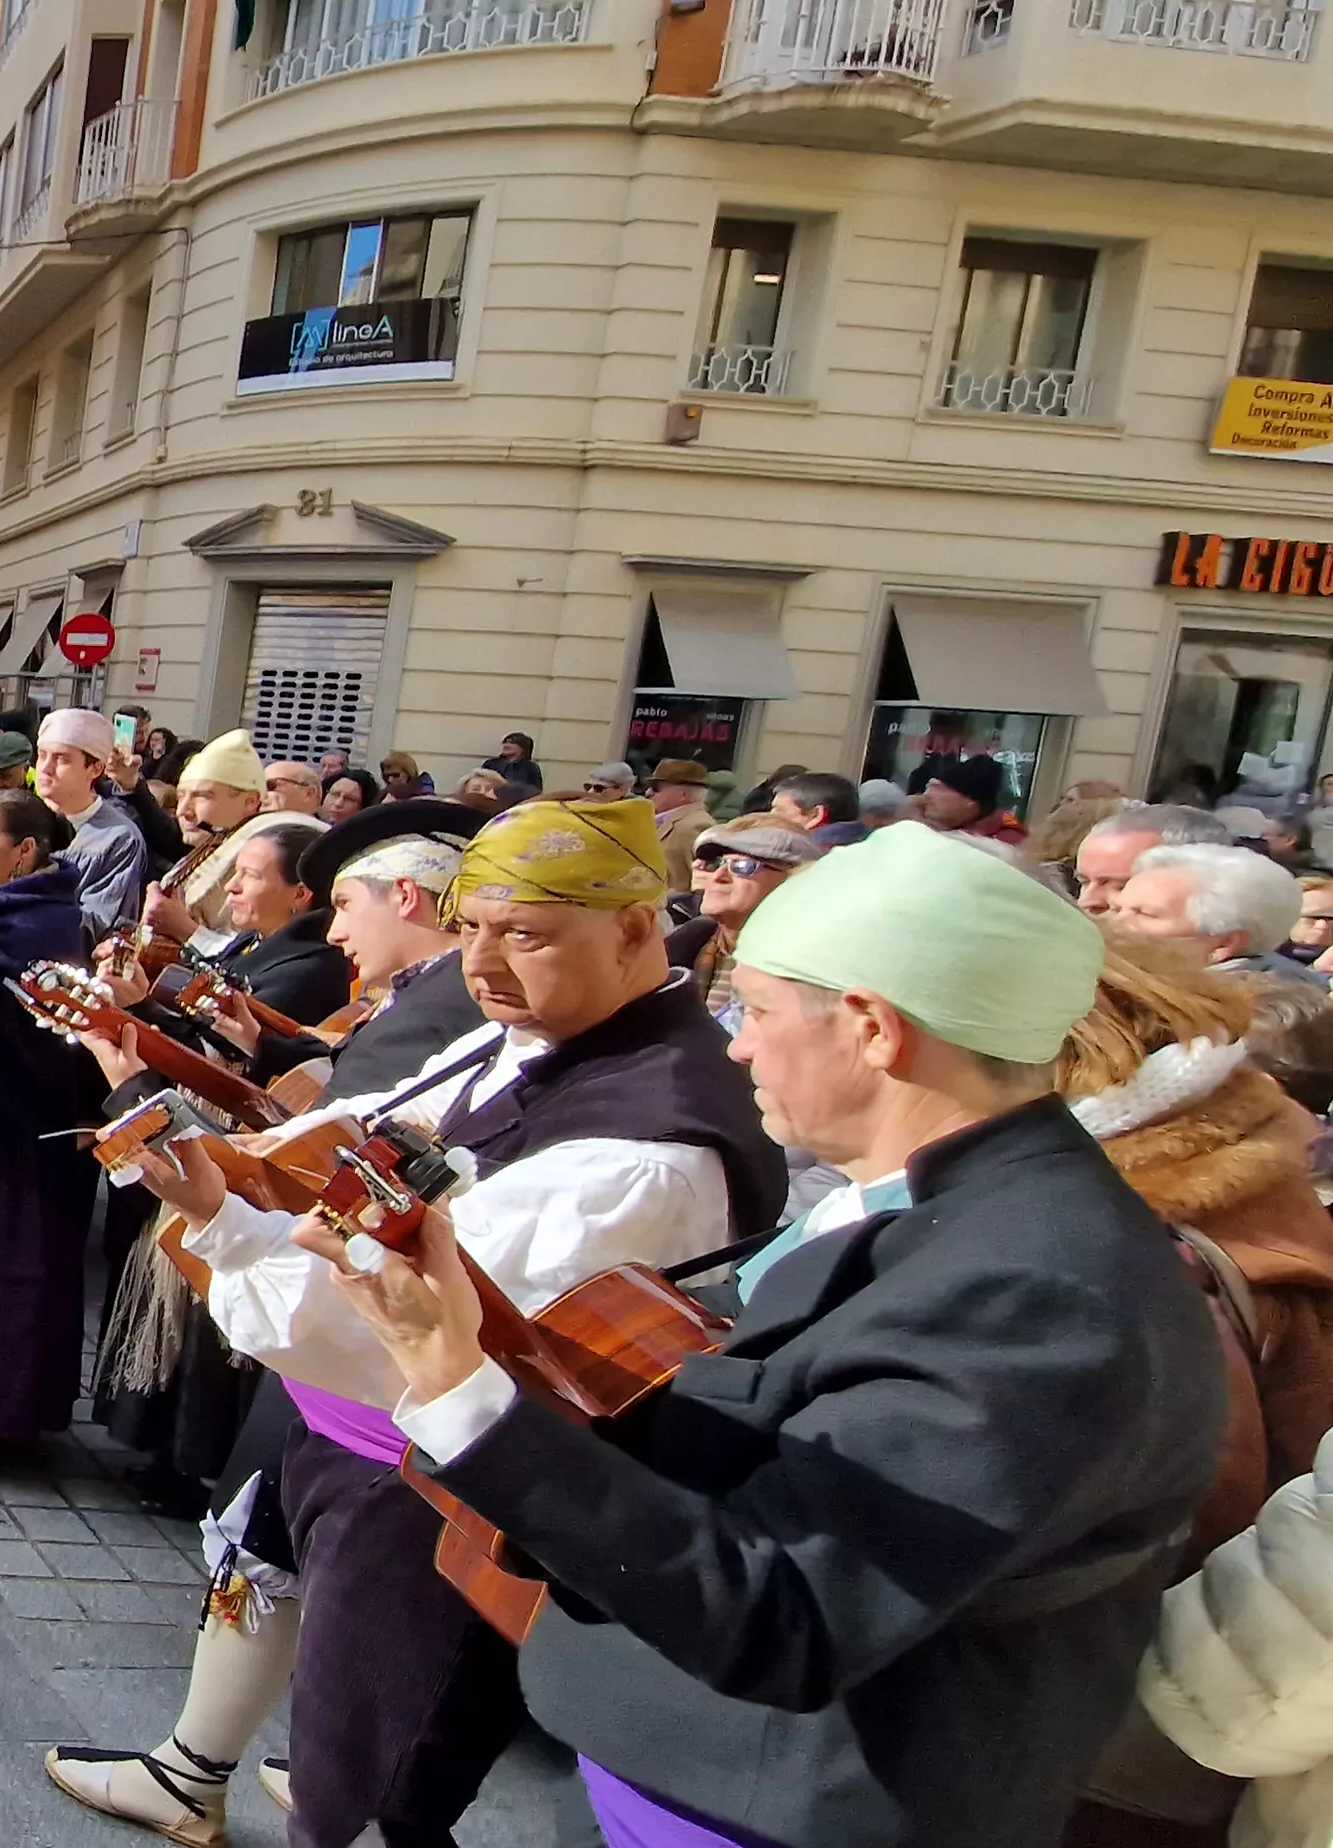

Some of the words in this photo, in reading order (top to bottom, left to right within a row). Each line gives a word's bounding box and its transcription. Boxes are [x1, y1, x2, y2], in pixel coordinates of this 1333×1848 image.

[336, 350, 393, 363] arquitectura
[1253, 384, 1315, 404] Compra
[1261, 421, 1329, 439] Reformas
[1171, 531, 1221, 588] LA
[630, 719, 730, 741] REBAJAS
